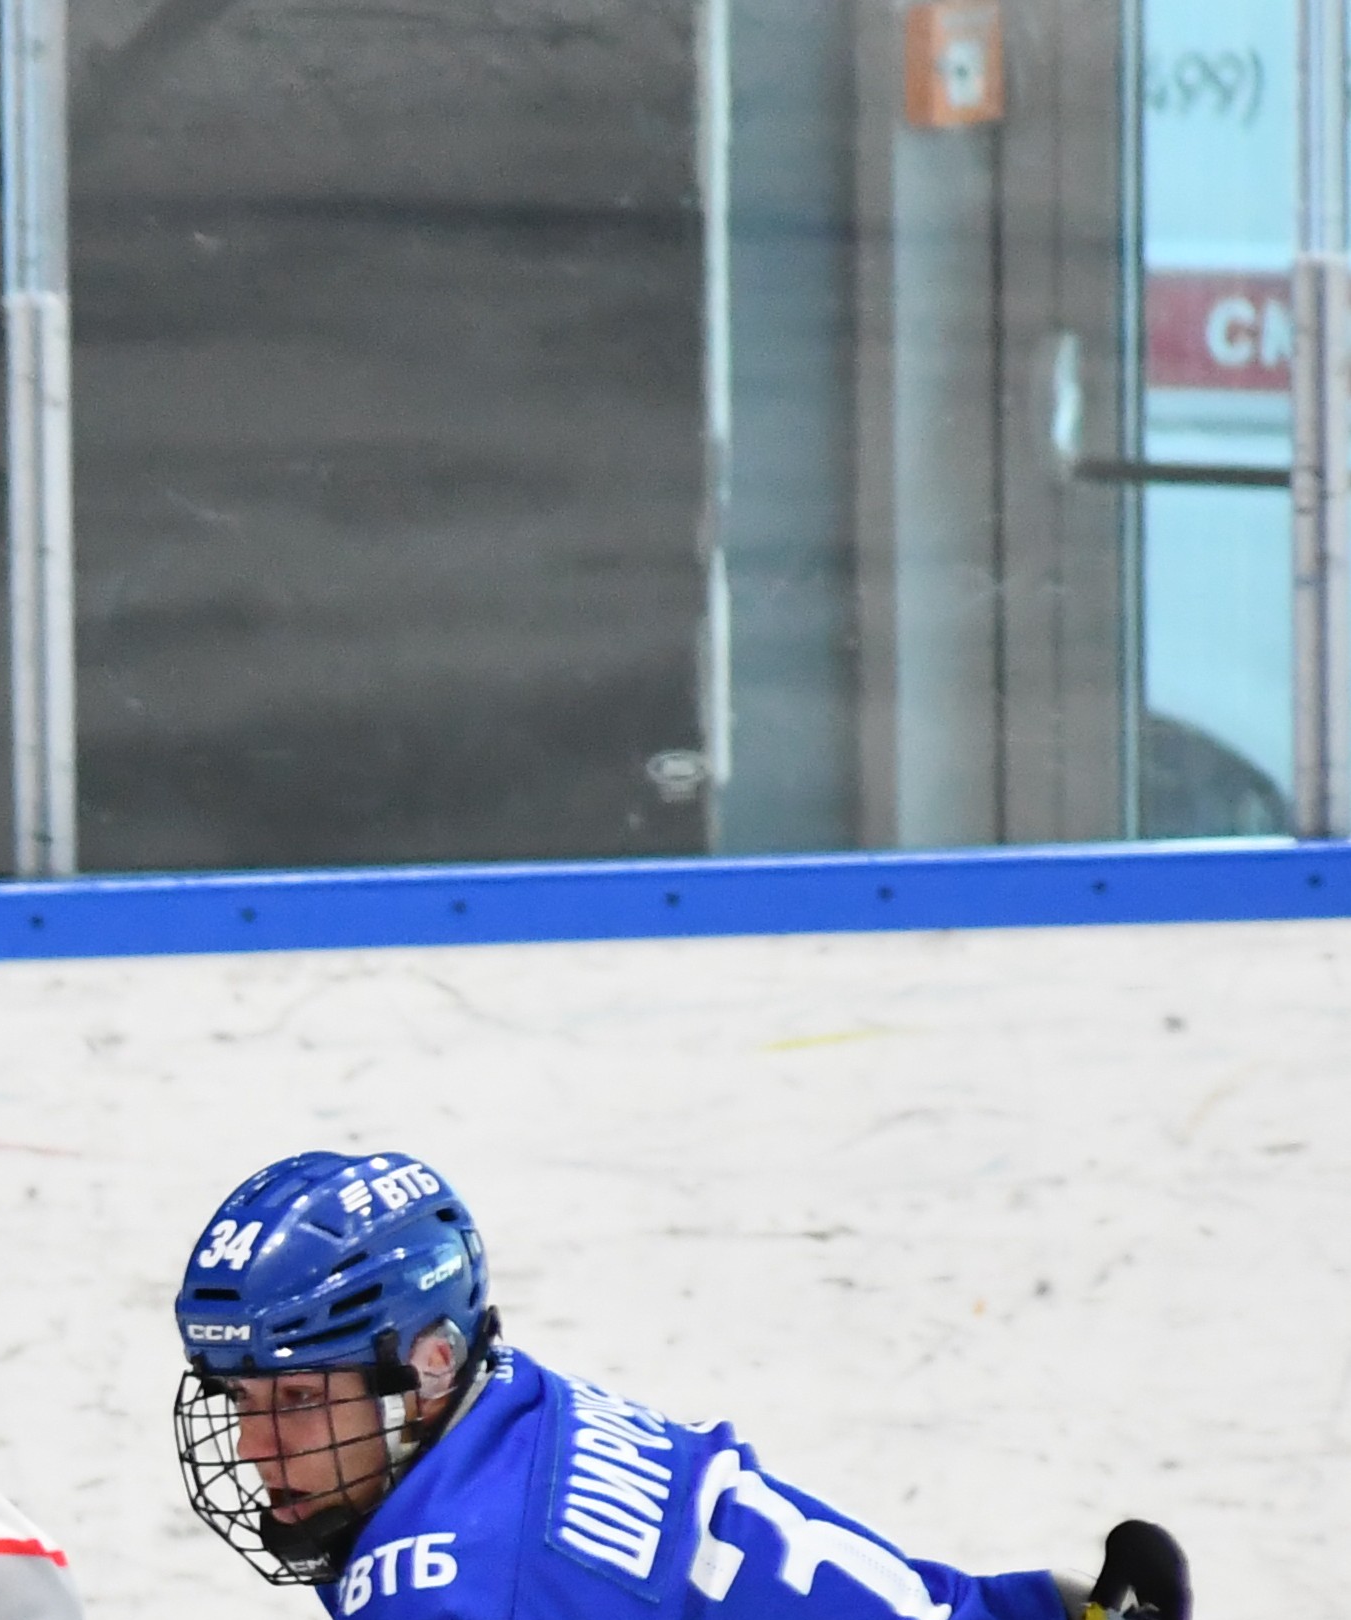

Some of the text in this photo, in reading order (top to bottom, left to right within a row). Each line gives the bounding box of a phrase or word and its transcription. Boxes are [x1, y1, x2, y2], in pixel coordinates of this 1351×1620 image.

[372, 1163, 440, 1211] ВТБ
[198, 1219, 263, 1271] 34
[418, 1254, 464, 1292] CCM
[186, 1323, 251, 1341] CCM
[343, 1532, 458, 1617] ВТБ
